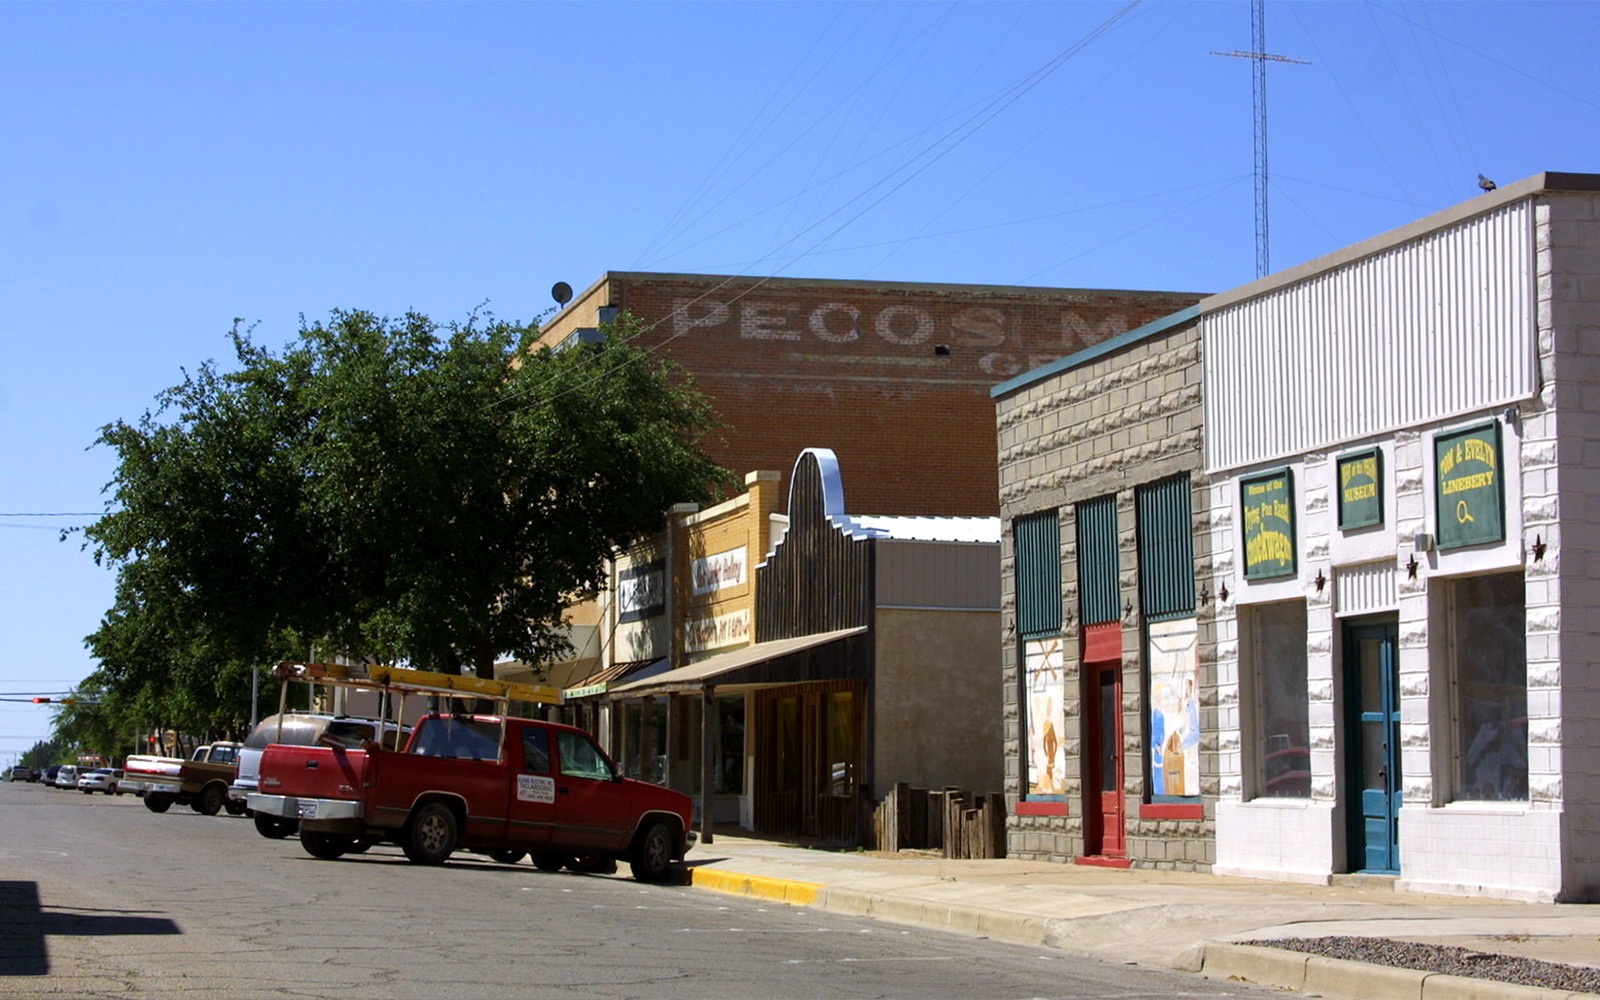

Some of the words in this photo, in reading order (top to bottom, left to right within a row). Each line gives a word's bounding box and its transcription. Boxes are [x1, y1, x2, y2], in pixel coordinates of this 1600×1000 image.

[672, 298, 1006, 347] PECOS
[1456, 442, 1463, 464] &
[1343, 482, 1376, 502] MUSEUM
[1442, 471, 1494, 495] LINEBERY
